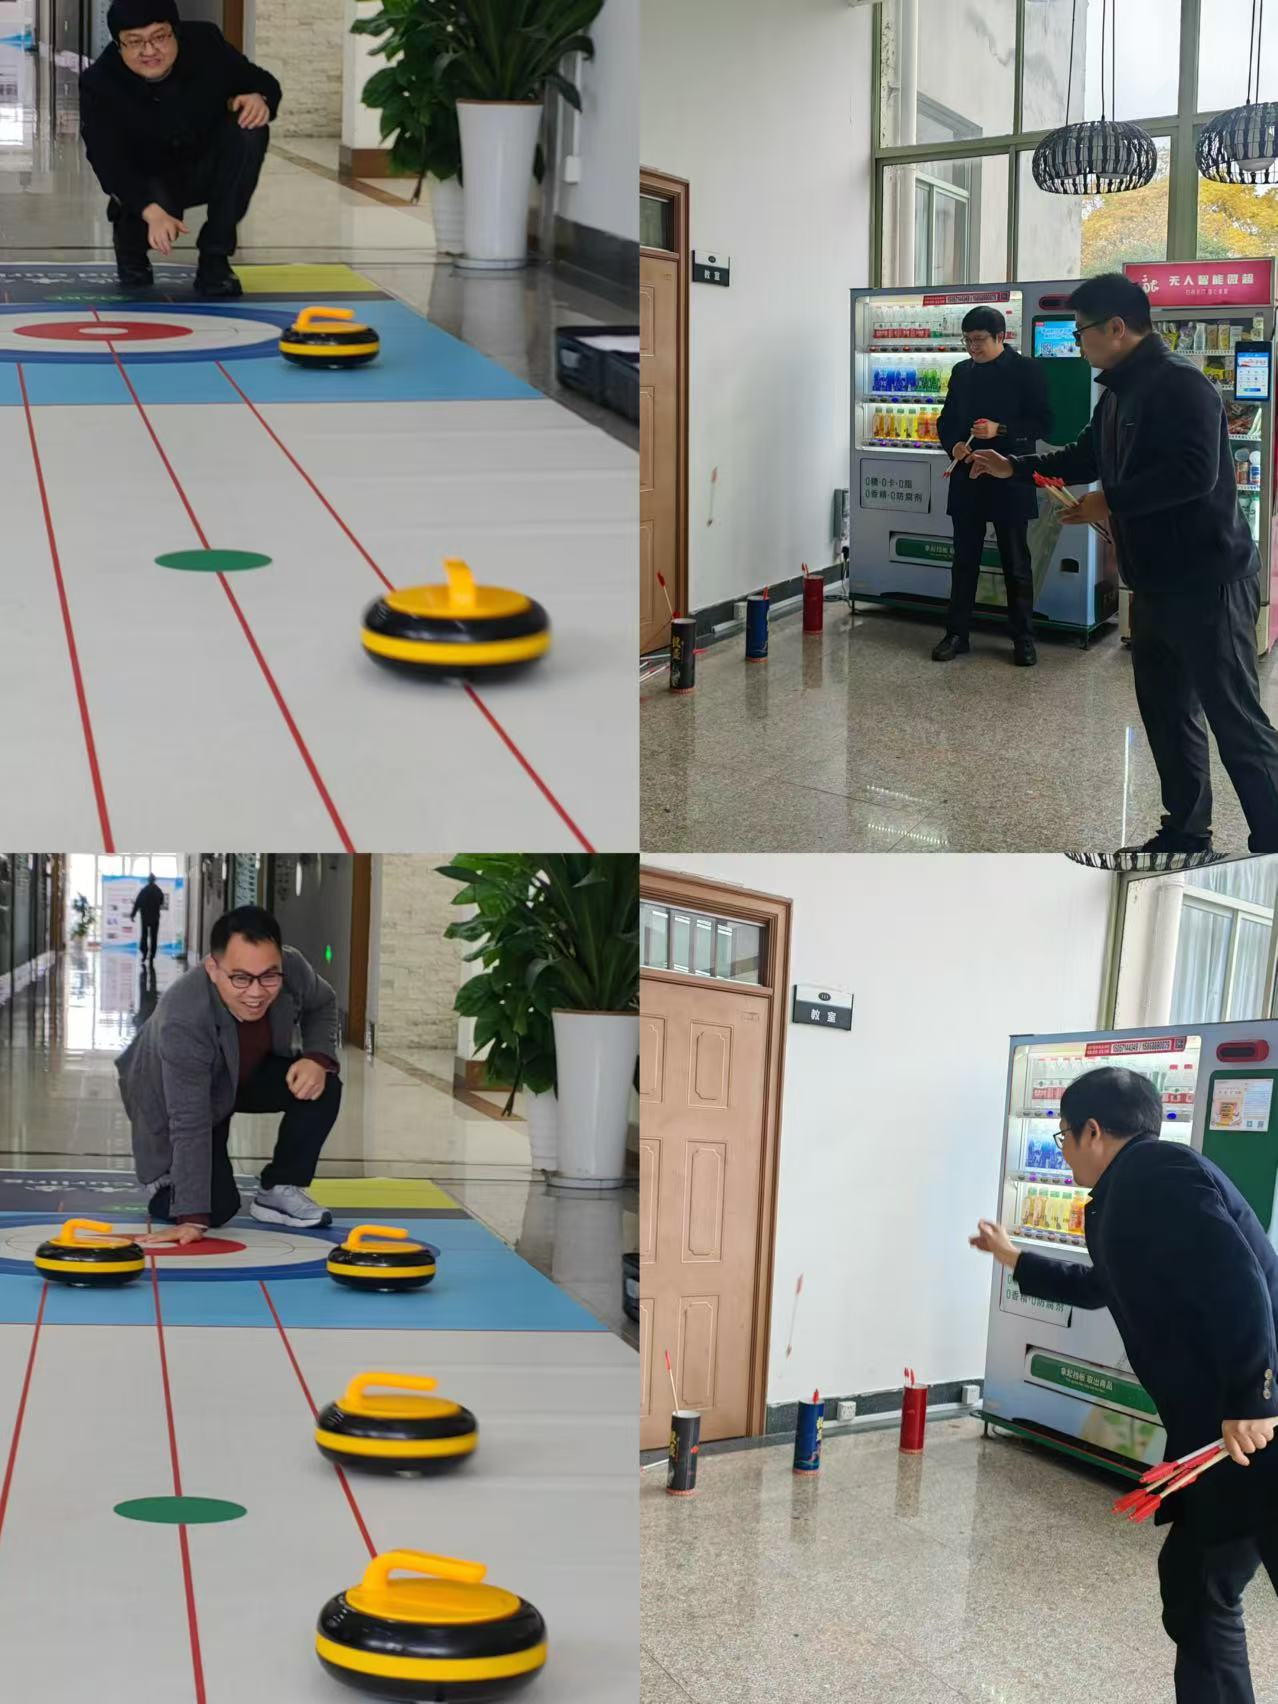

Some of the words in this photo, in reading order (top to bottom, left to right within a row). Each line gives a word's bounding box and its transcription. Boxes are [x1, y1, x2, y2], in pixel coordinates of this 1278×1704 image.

[1168, 273, 1255, 287] 无人智能微超
[811, 1008, 837, 1023] 教室
